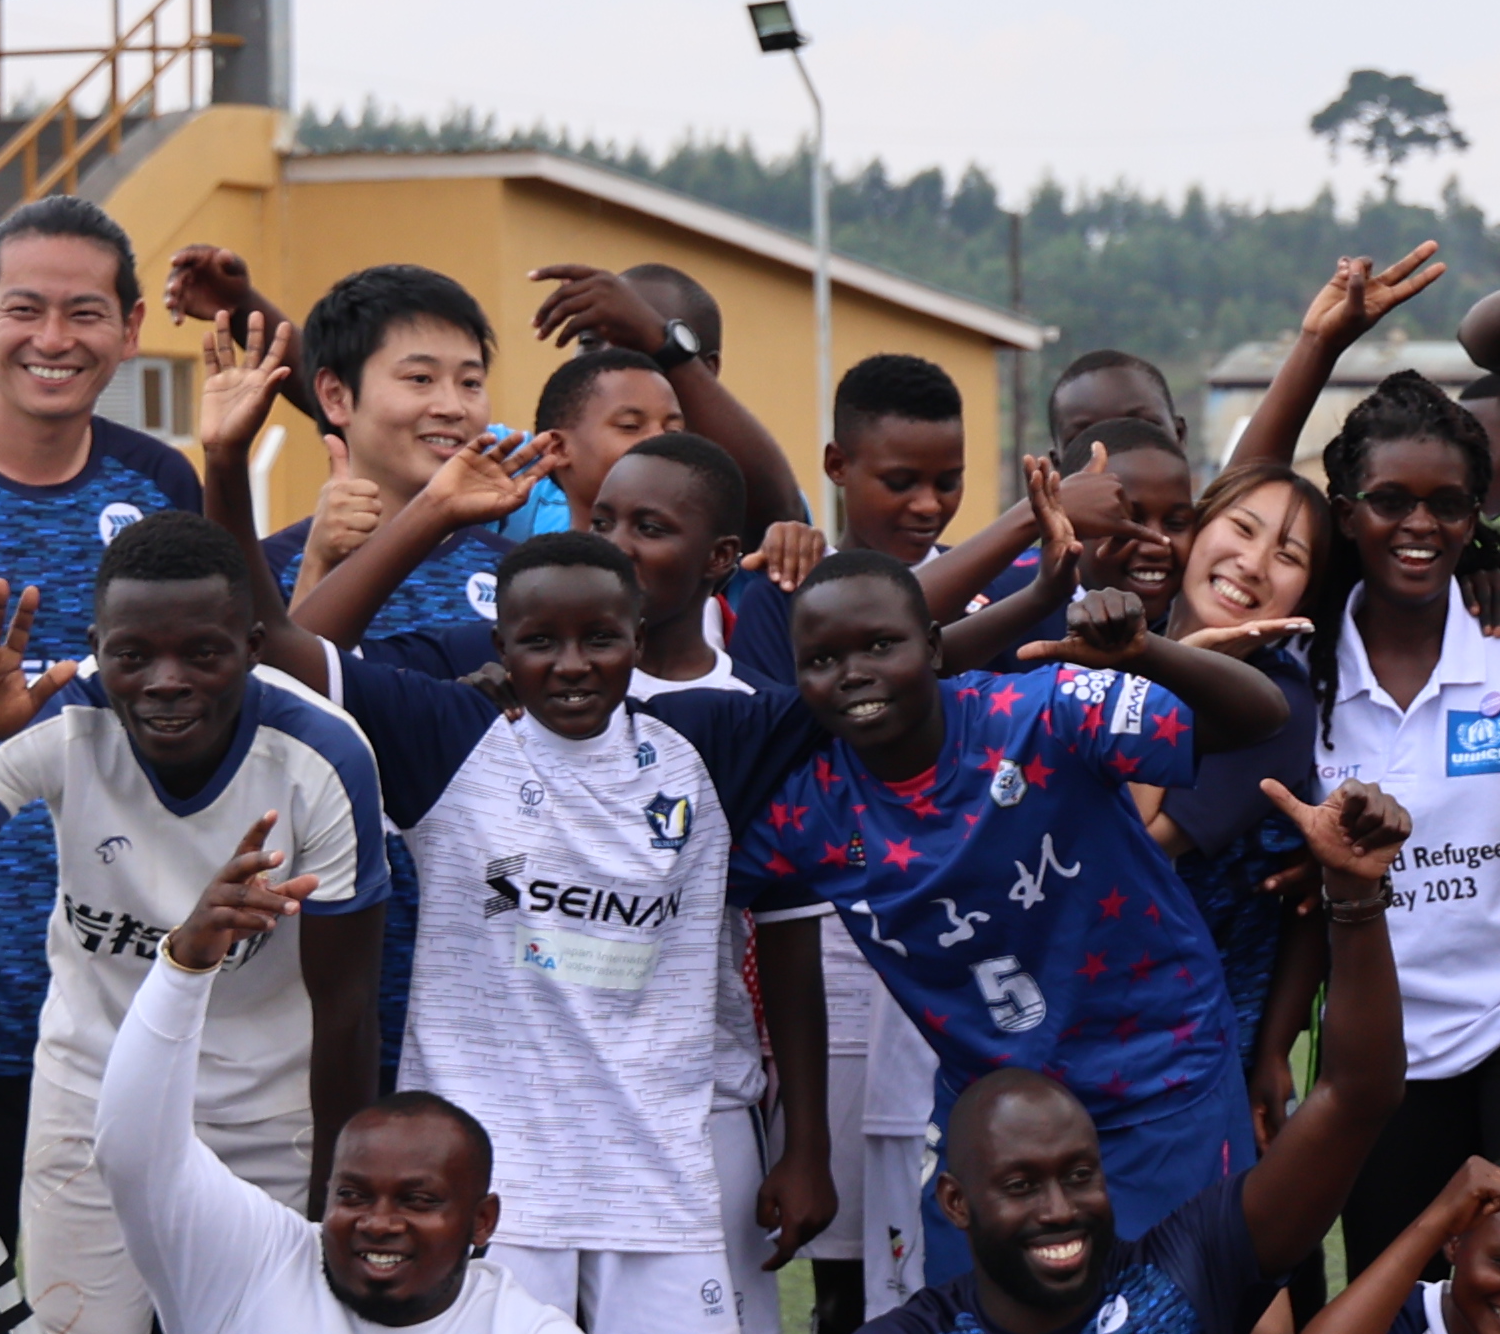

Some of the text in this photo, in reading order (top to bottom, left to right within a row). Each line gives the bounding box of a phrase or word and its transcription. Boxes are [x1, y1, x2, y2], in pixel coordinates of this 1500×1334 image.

[529, 879, 684, 928] SEINAN
[1388, 876, 1478, 913] ay 2023
[523, 945, 557, 970] JICA
[970, 953, 1047, 1034] 5
